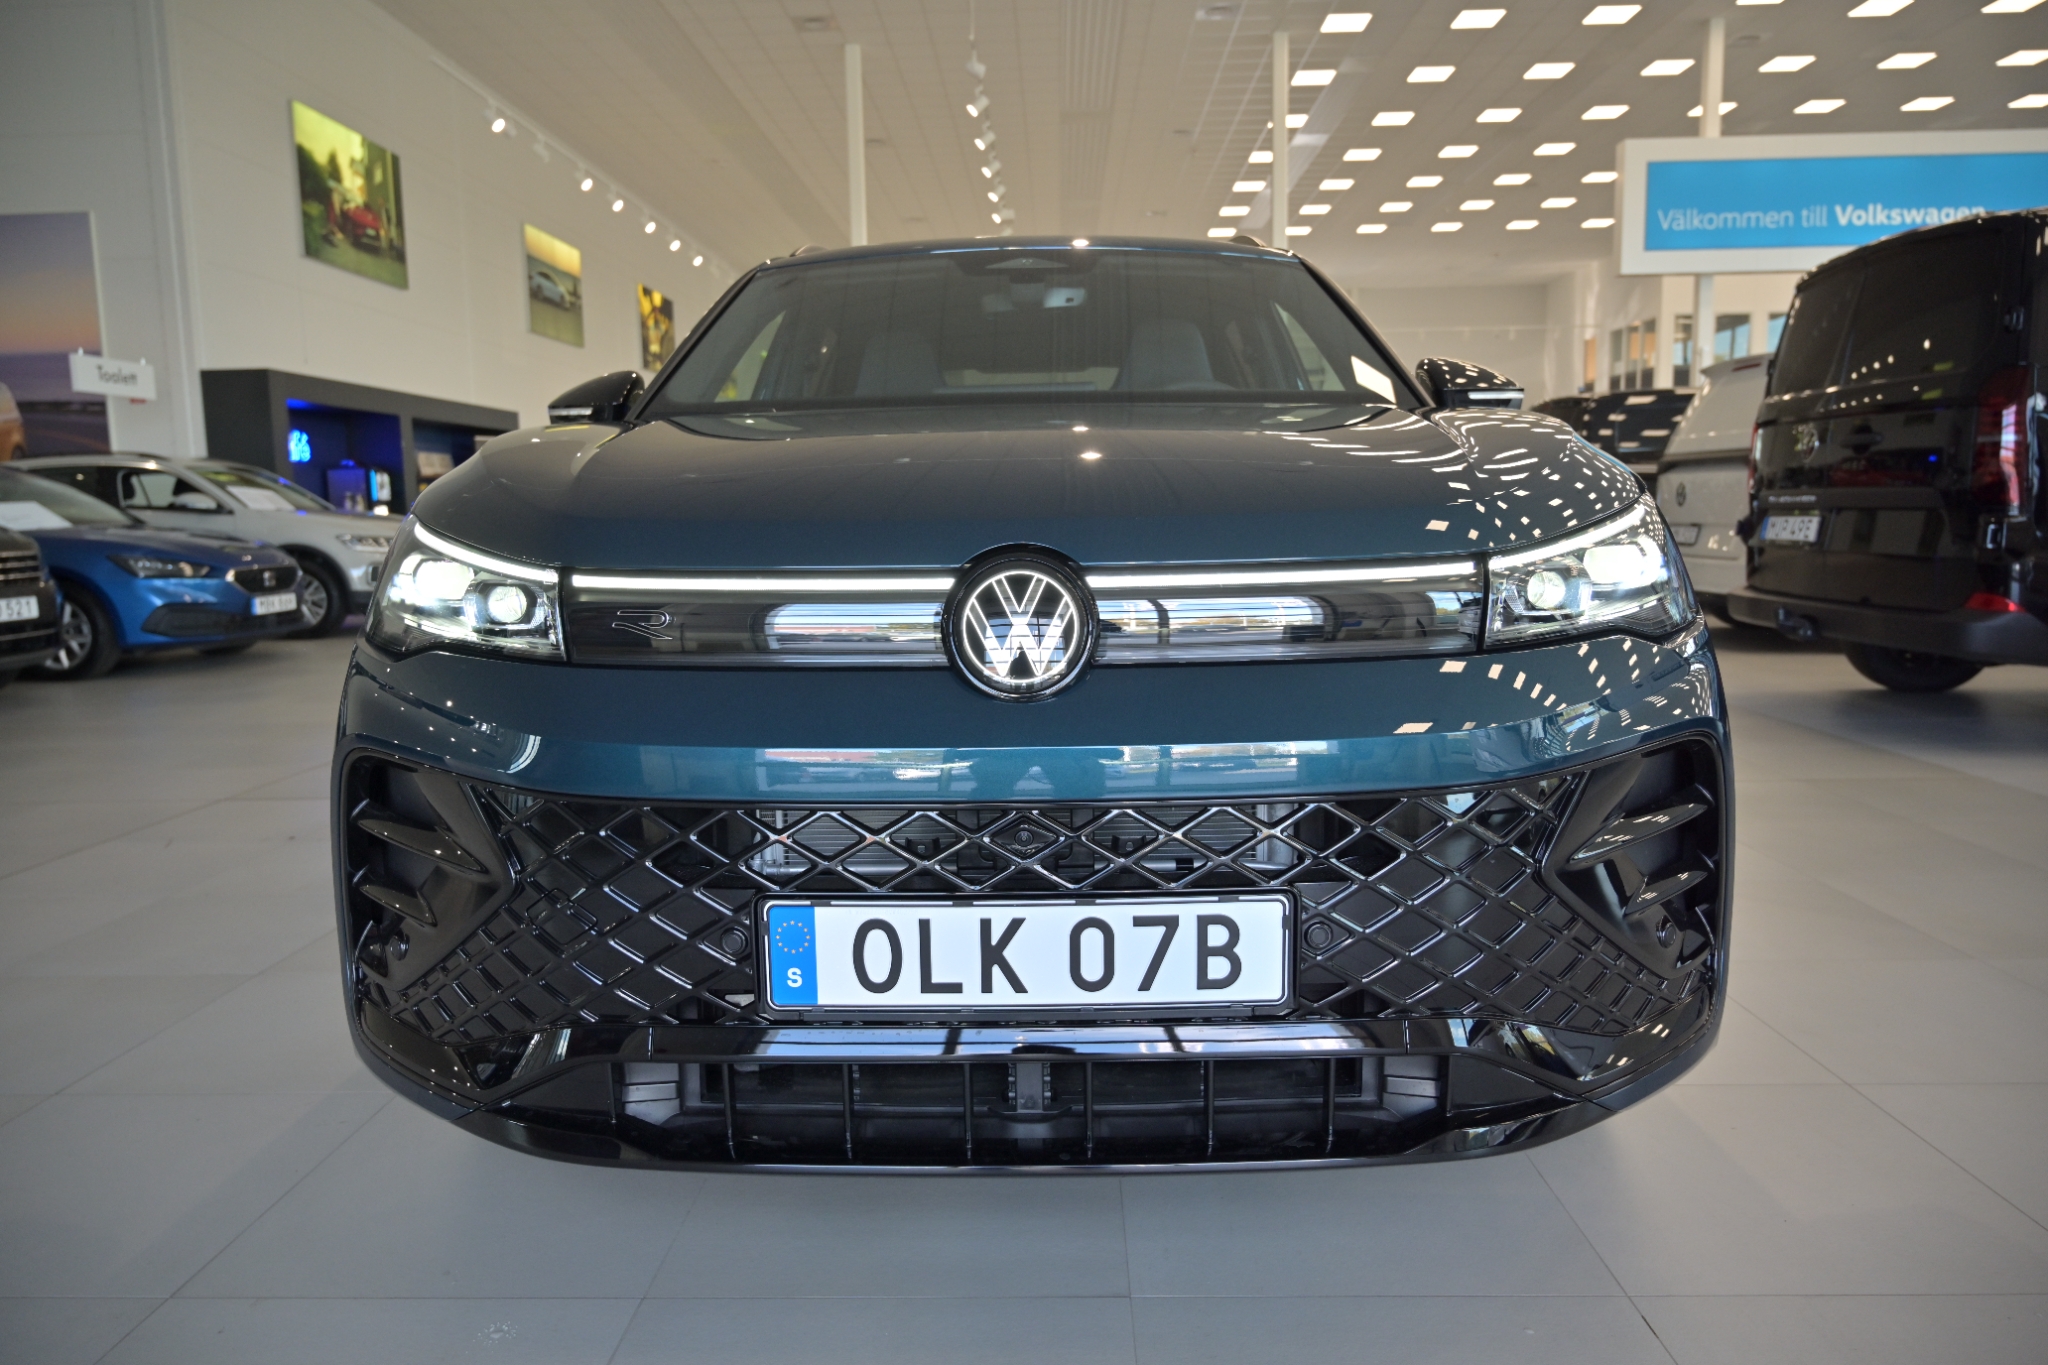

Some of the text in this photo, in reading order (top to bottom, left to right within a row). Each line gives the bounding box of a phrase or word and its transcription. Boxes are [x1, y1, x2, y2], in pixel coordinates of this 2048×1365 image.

[1657, 208, 1794, 231] Välkommen
[1801, 205, 1828, 227] till
[852, 914, 1242, 994] OLK 07B
[787, 967, 803, 988] S
